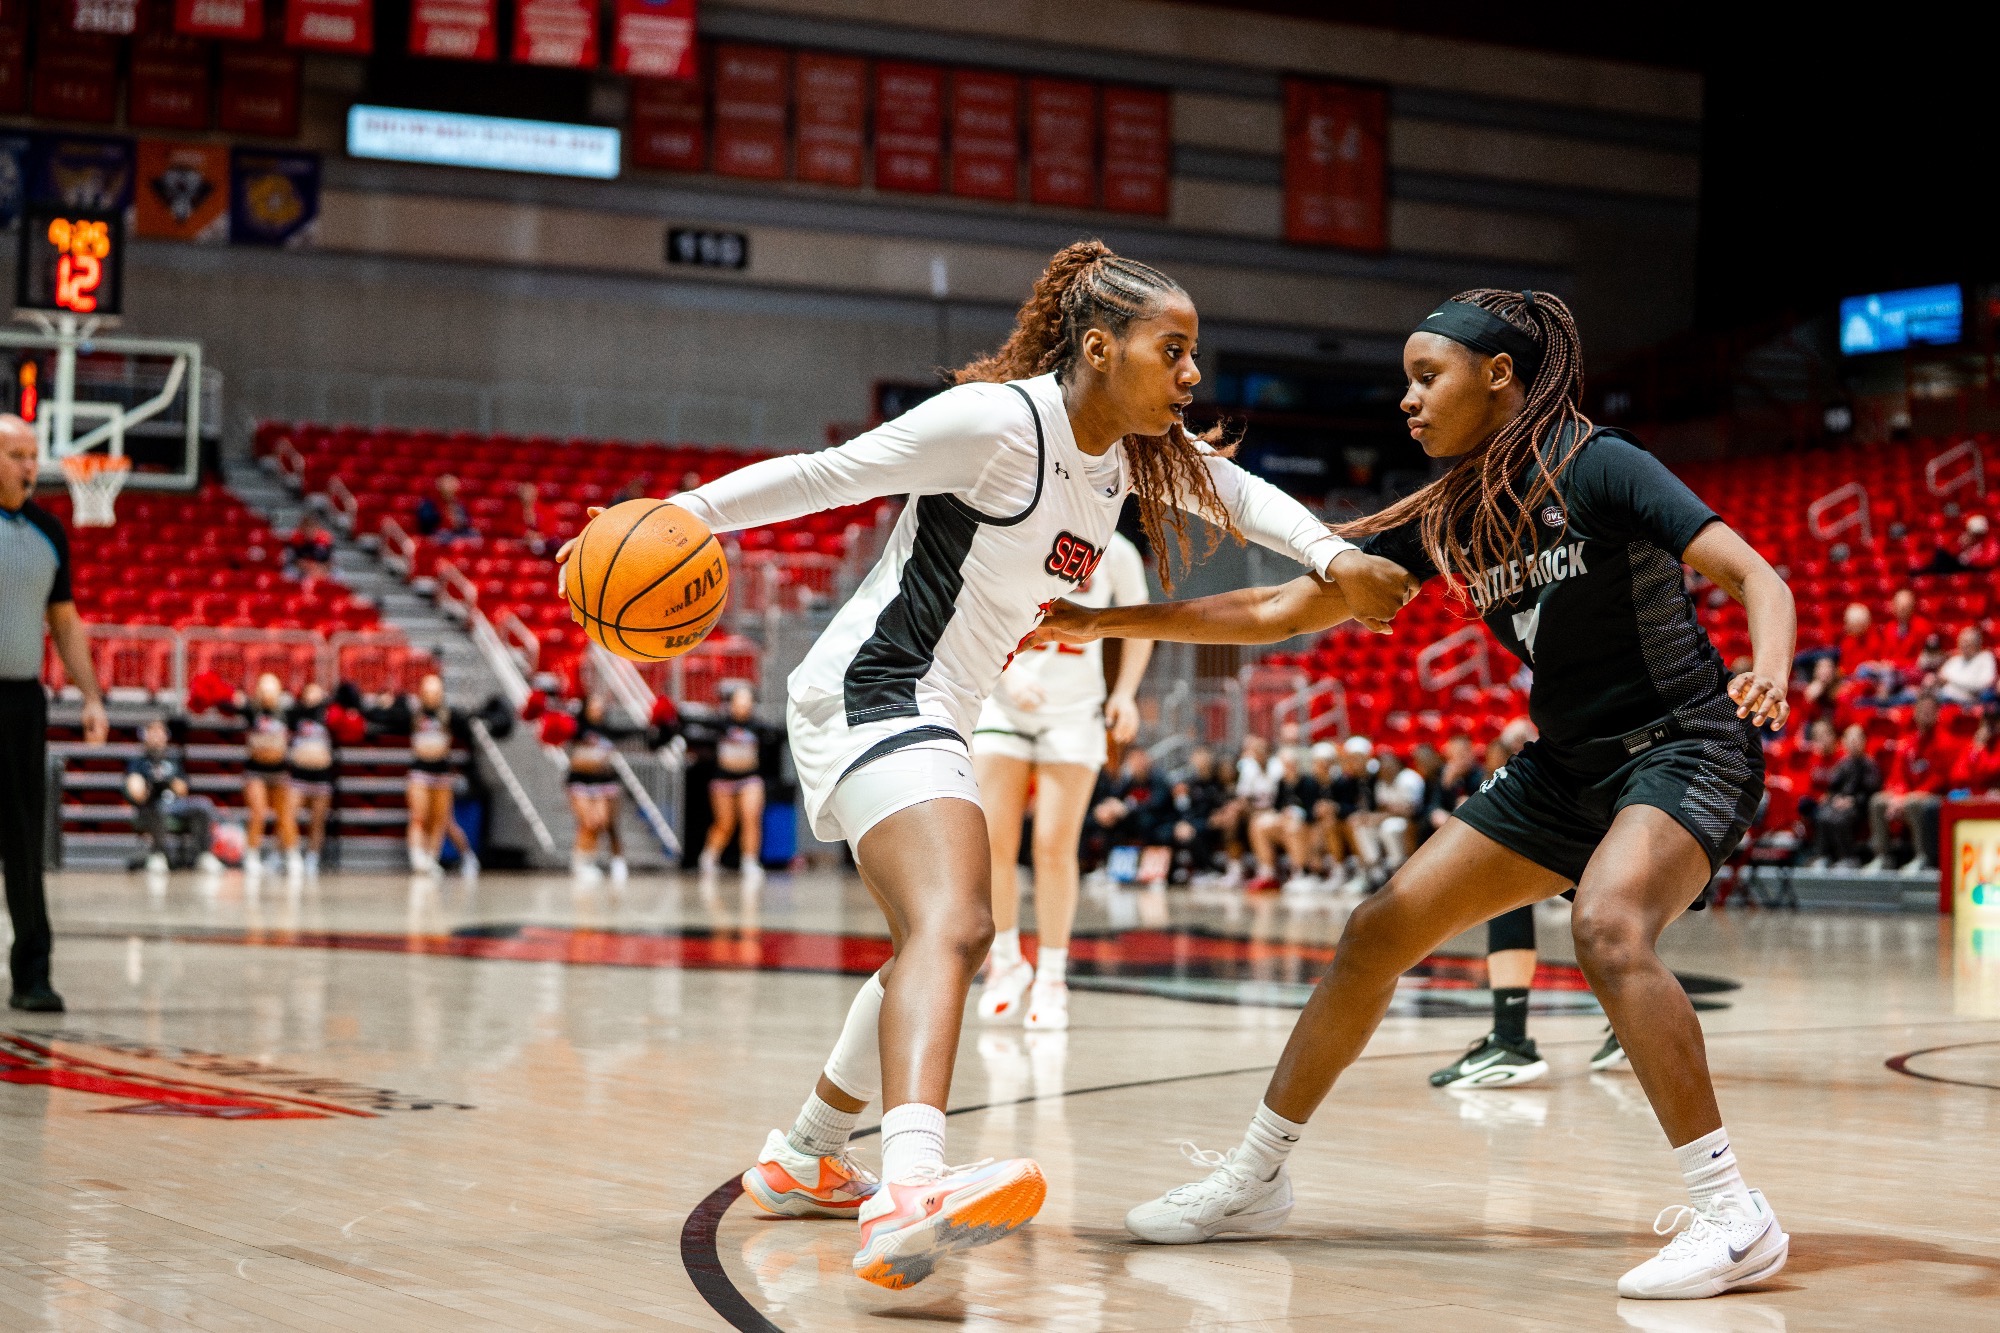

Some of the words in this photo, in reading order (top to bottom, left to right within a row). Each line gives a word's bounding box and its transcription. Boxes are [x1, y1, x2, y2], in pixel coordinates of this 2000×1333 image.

[56, 254, 102, 313] 12
[684, 556, 723, 608] EVO
[1526, 541, 1588, 588] ROCK
[663, 602, 684, 618] NXT
[1654, 729, 1665, 740] M
